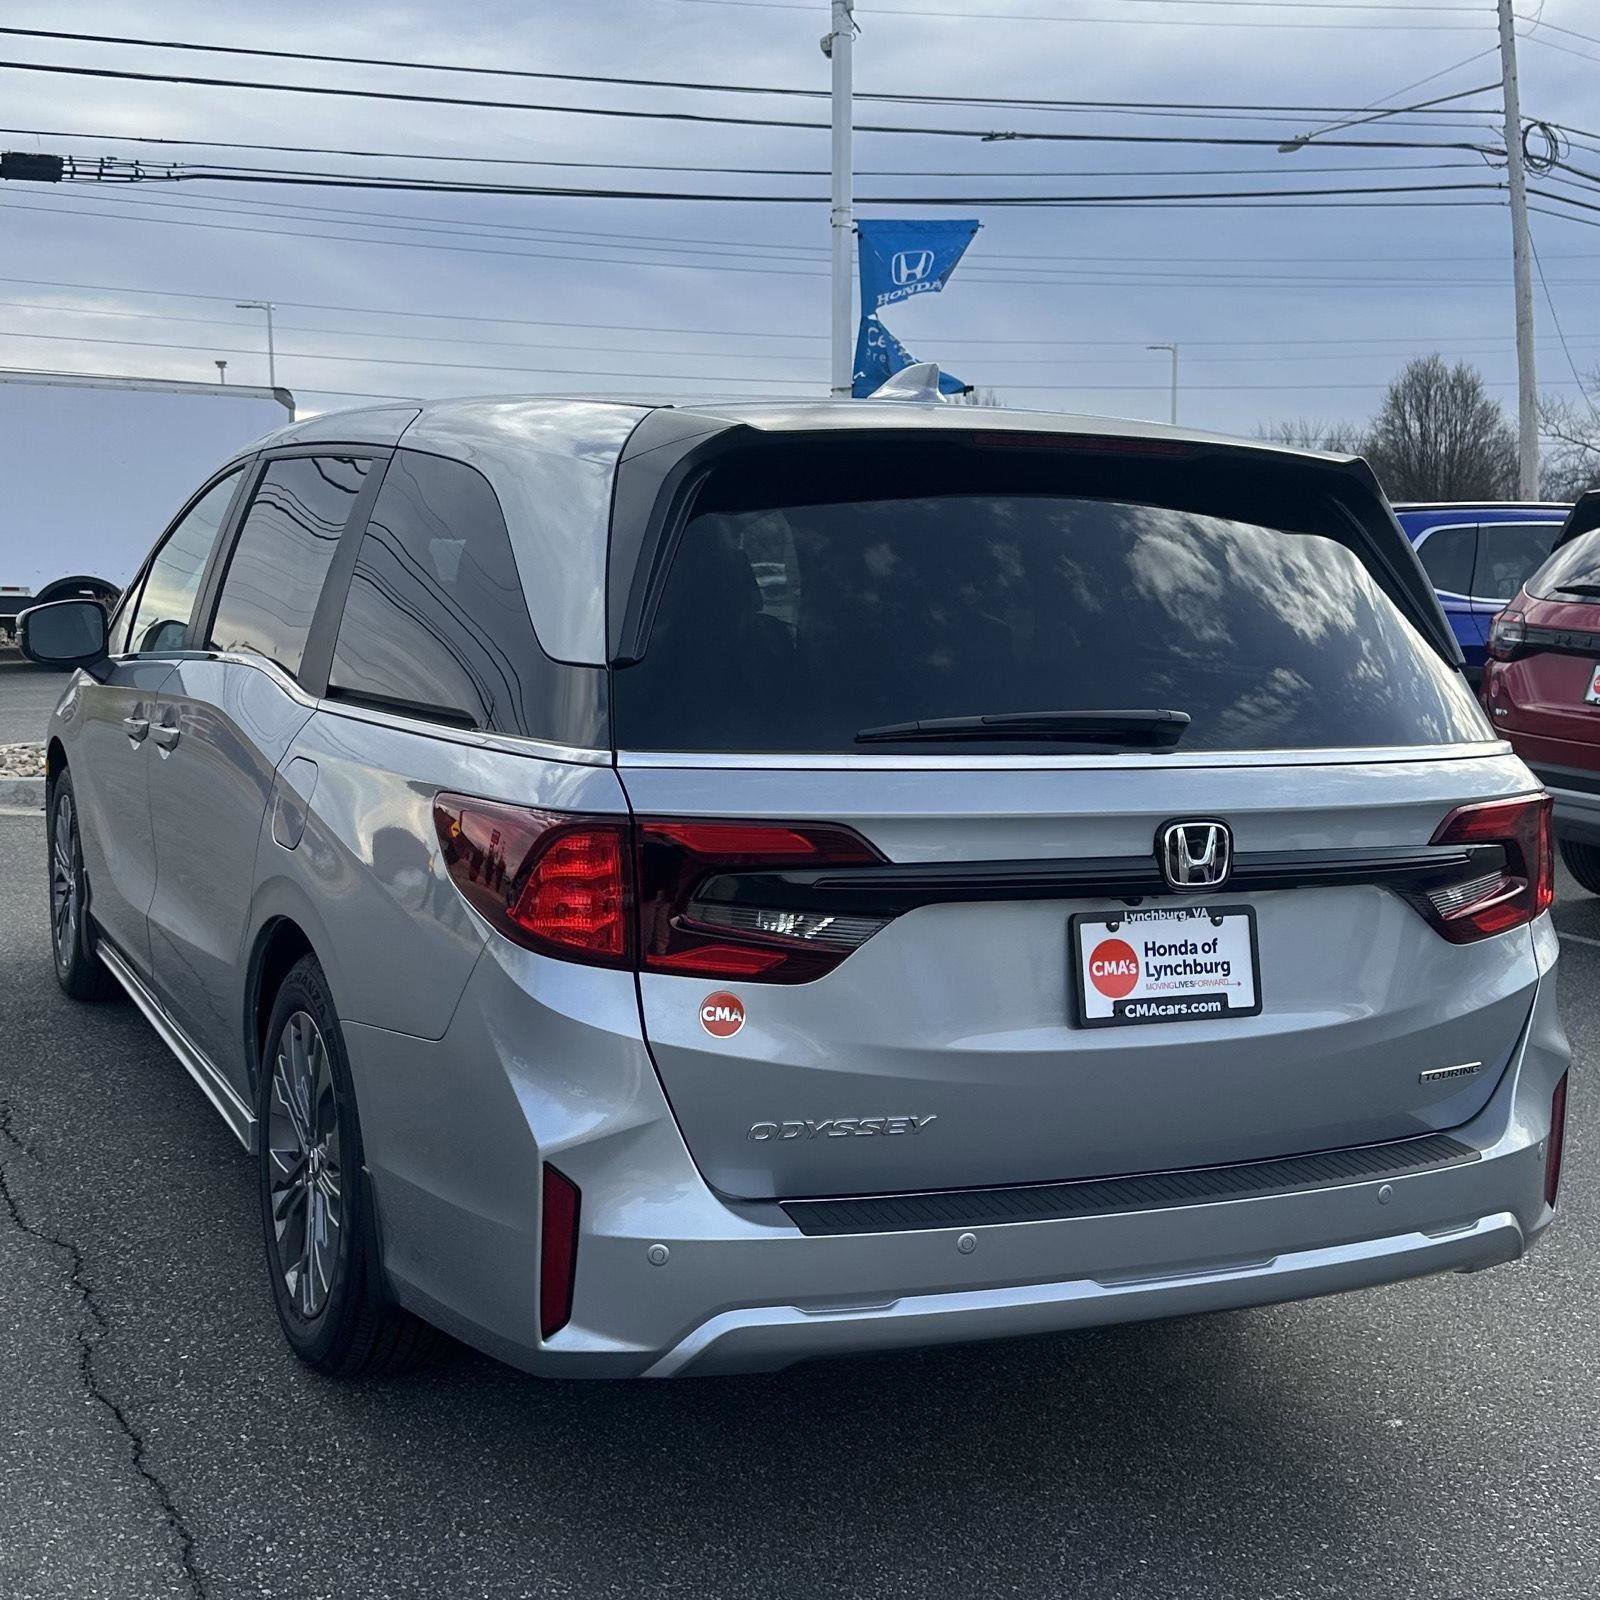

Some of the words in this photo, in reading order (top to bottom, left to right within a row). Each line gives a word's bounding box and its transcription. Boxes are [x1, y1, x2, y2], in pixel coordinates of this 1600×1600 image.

[877, 280, 943, 306] HONDA
[1193, 907, 1209, 919] VA
[1144, 939, 1199, 958] Honda
[1201, 938, 1218, 954] of
[1091, 959, 1137, 977] CMA's
[1145, 960, 1231, 981] Lynchburg
[702, 1006, 743, 1023] CMA
[1124, 1000, 1222, 1018] CMAcars.com
[1425, 1065, 1480, 1081] TOURING
[748, 1114, 938, 1143] ODYSSEY
